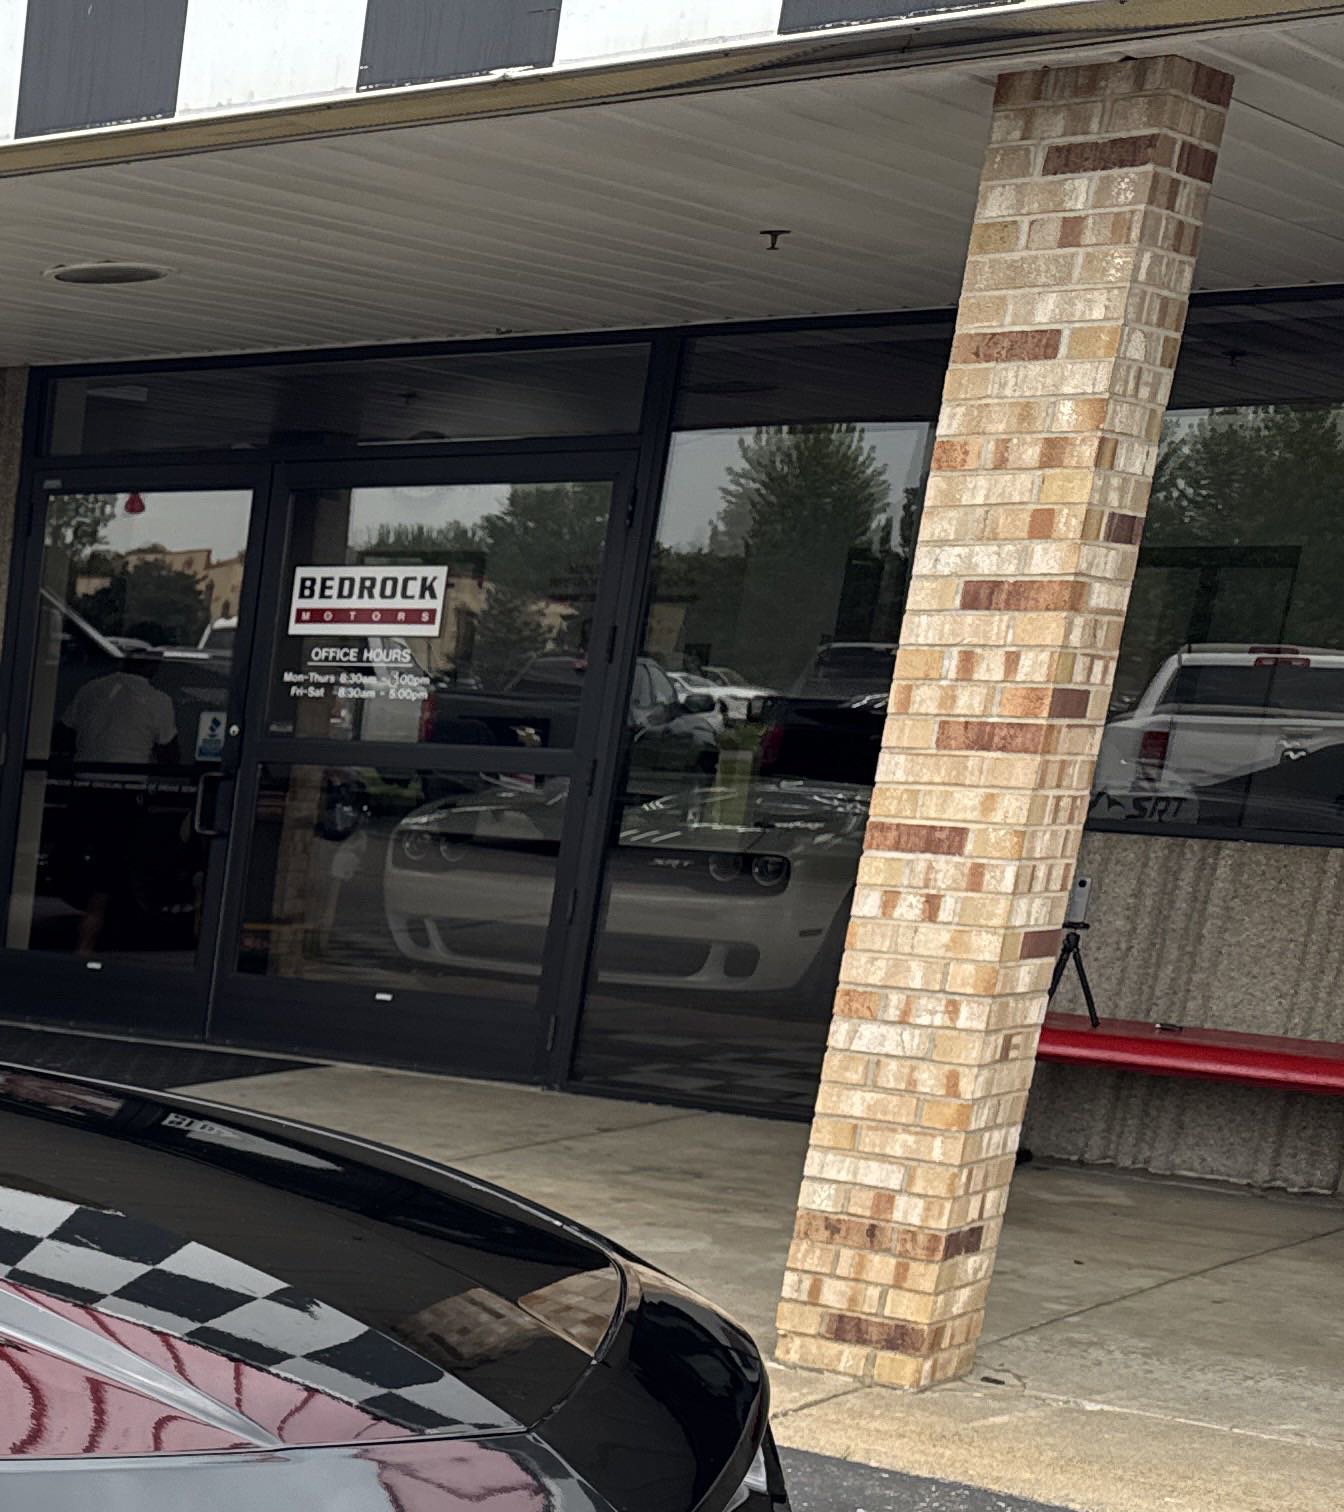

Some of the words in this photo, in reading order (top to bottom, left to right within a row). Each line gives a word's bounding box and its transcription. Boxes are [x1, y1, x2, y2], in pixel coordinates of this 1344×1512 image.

[298, 575, 438, 600] BEDROCK
[301, 610, 430, 622] MOTORS
[311, 647, 358, 662] OFFICE
[362, 648, 412, 663] HOURS
